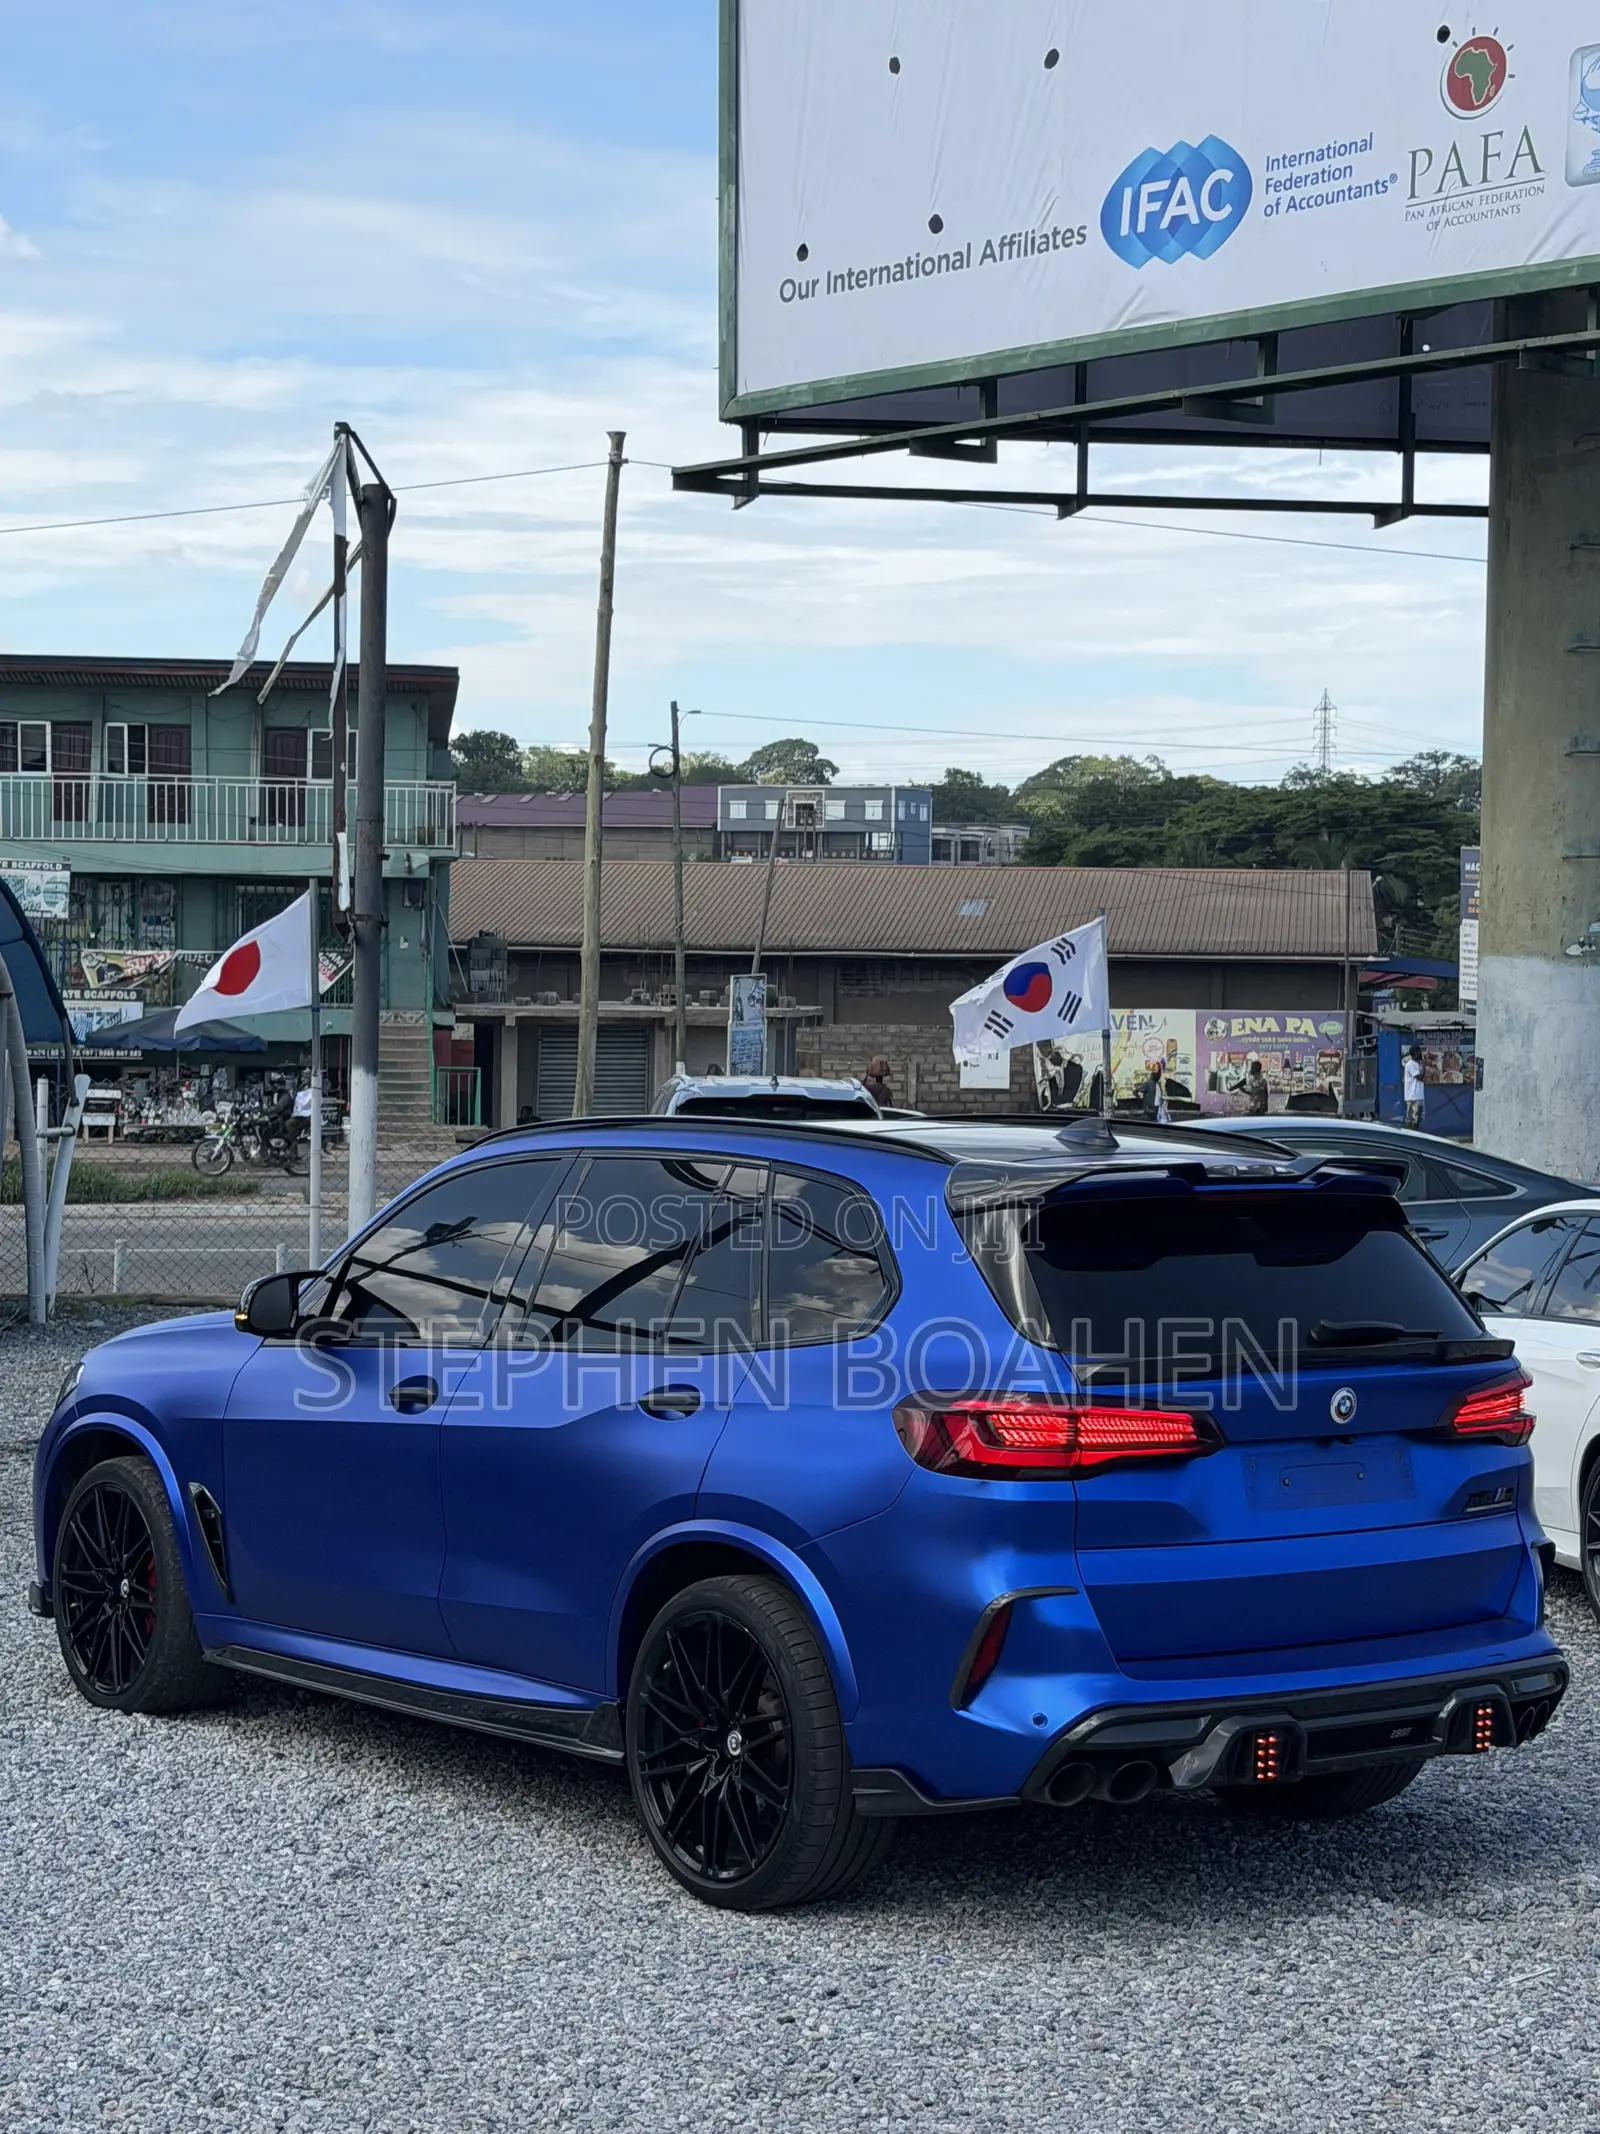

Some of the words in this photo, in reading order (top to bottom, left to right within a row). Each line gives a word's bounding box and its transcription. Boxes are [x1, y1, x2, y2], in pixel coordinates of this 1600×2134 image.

[1265, 132, 1374, 172] International
[1406, 124, 1546, 201] PAFA
[1264, 162, 1353, 196] Federation
[1119, 168, 1235, 237] IFAC
[1263, 200, 1281, 218] of
[1404, 207, 1425, 222] PAN
[1428, 198, 1475, 218] AFRICAN
[1479, 184, 1546, 206] FEDERATION
[1425, 218, 1441, 232] OF
[1443, 204, 1521, 229] ACCOUNTANTS
[778, 276, 820, 304] Our
[825, 242, 973, 296] International
[977, 224, 1088, 267] Affiliates
[11, 861, 63, 871] SCAFFOLD
[61, 989, 81, 999] ATE
[84, 989, 137, 1000] SCAFFOLD
[1230, 1016, 1280, 1037] ENA
[1285, 1016, 1318, 1039] PA
